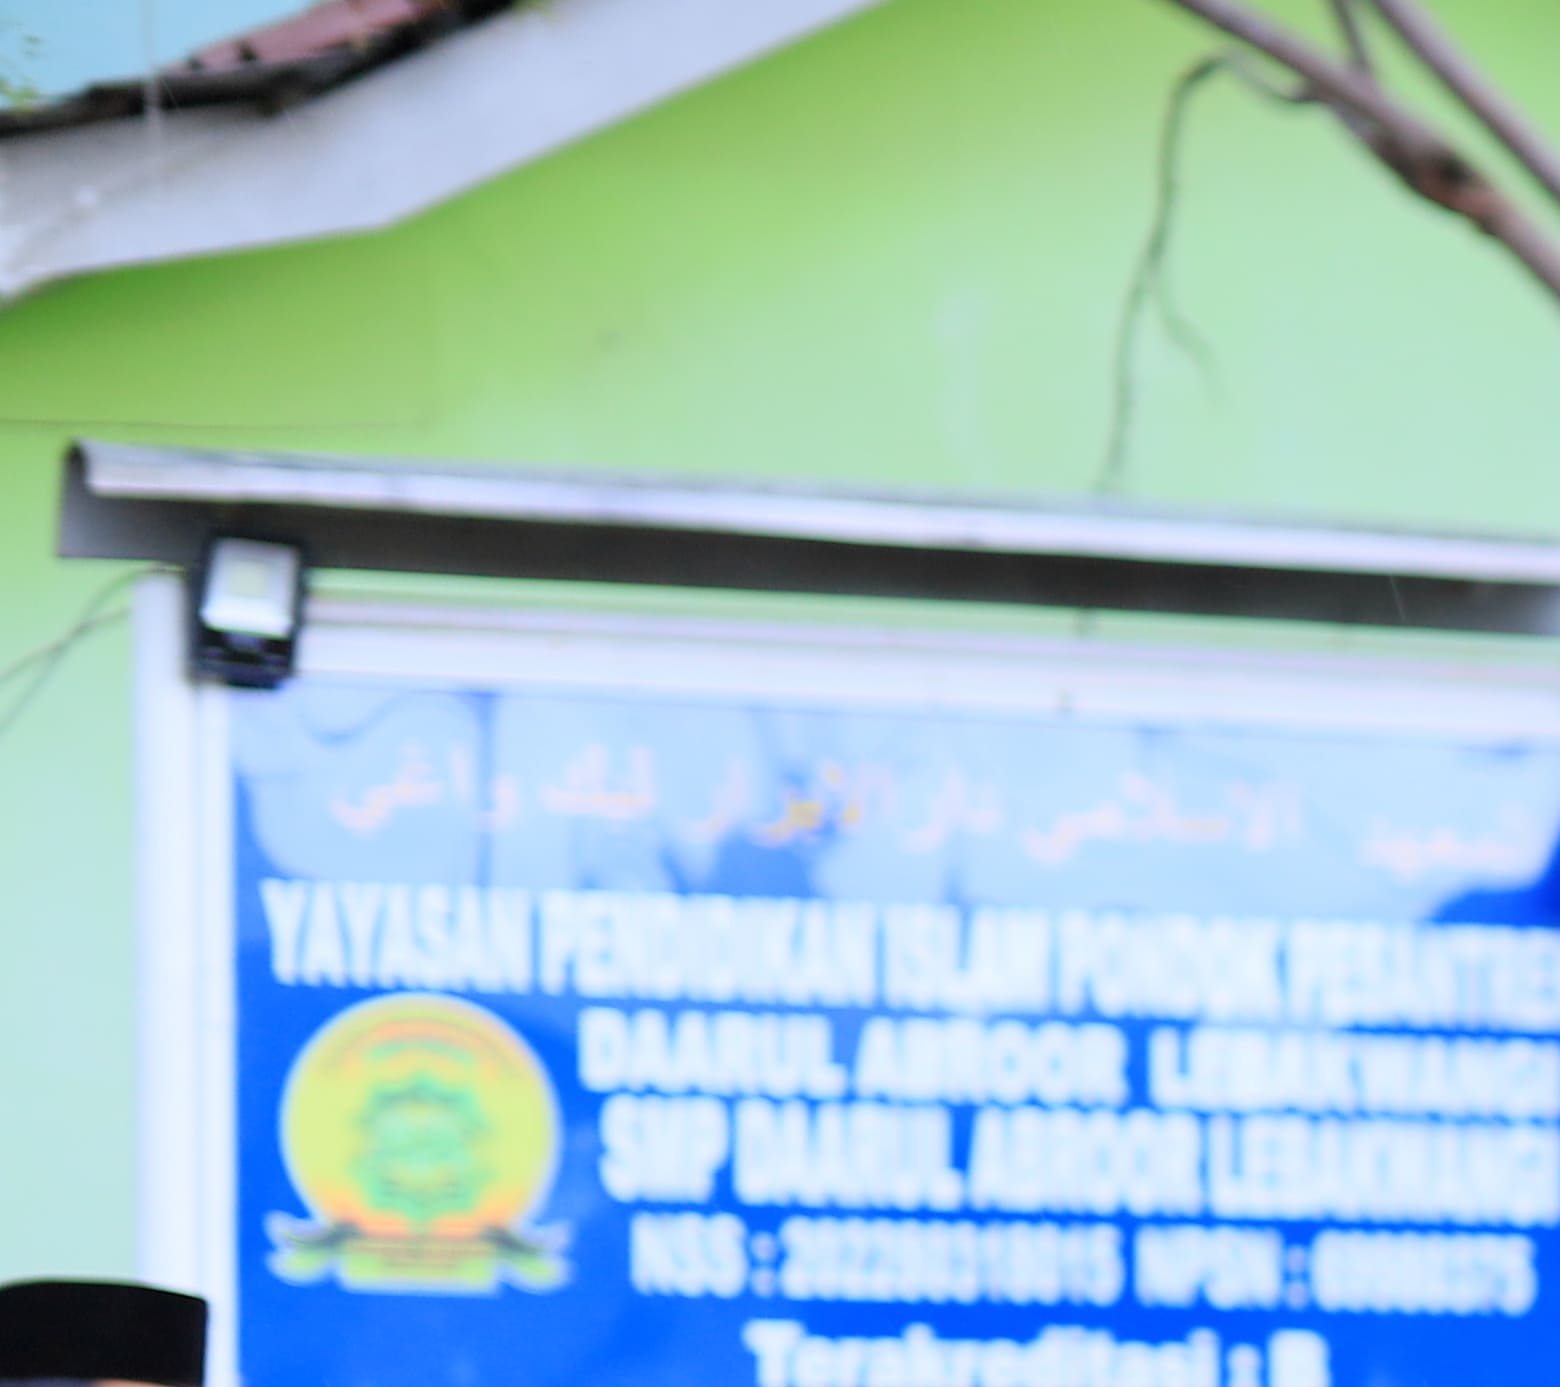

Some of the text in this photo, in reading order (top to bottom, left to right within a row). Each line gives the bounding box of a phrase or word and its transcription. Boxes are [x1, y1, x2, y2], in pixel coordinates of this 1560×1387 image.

[259, 878, 534, 992] YAYASAN
[536, 888, 878, 1003] PENDIDIKAN
[884, 898, 1048, 1012] ISLAM
[1052, 903, 1280, 1020] PONDOK
[577, 1007, 846, 1098] DAARUL
[852, 1015, 1130, 1107] ABROOR
[600, 1094, 728, 1203] SMP
[732, 1099, 964, 1212] DAARUL
[966, 1106, 1205, 1217] ABROOR
